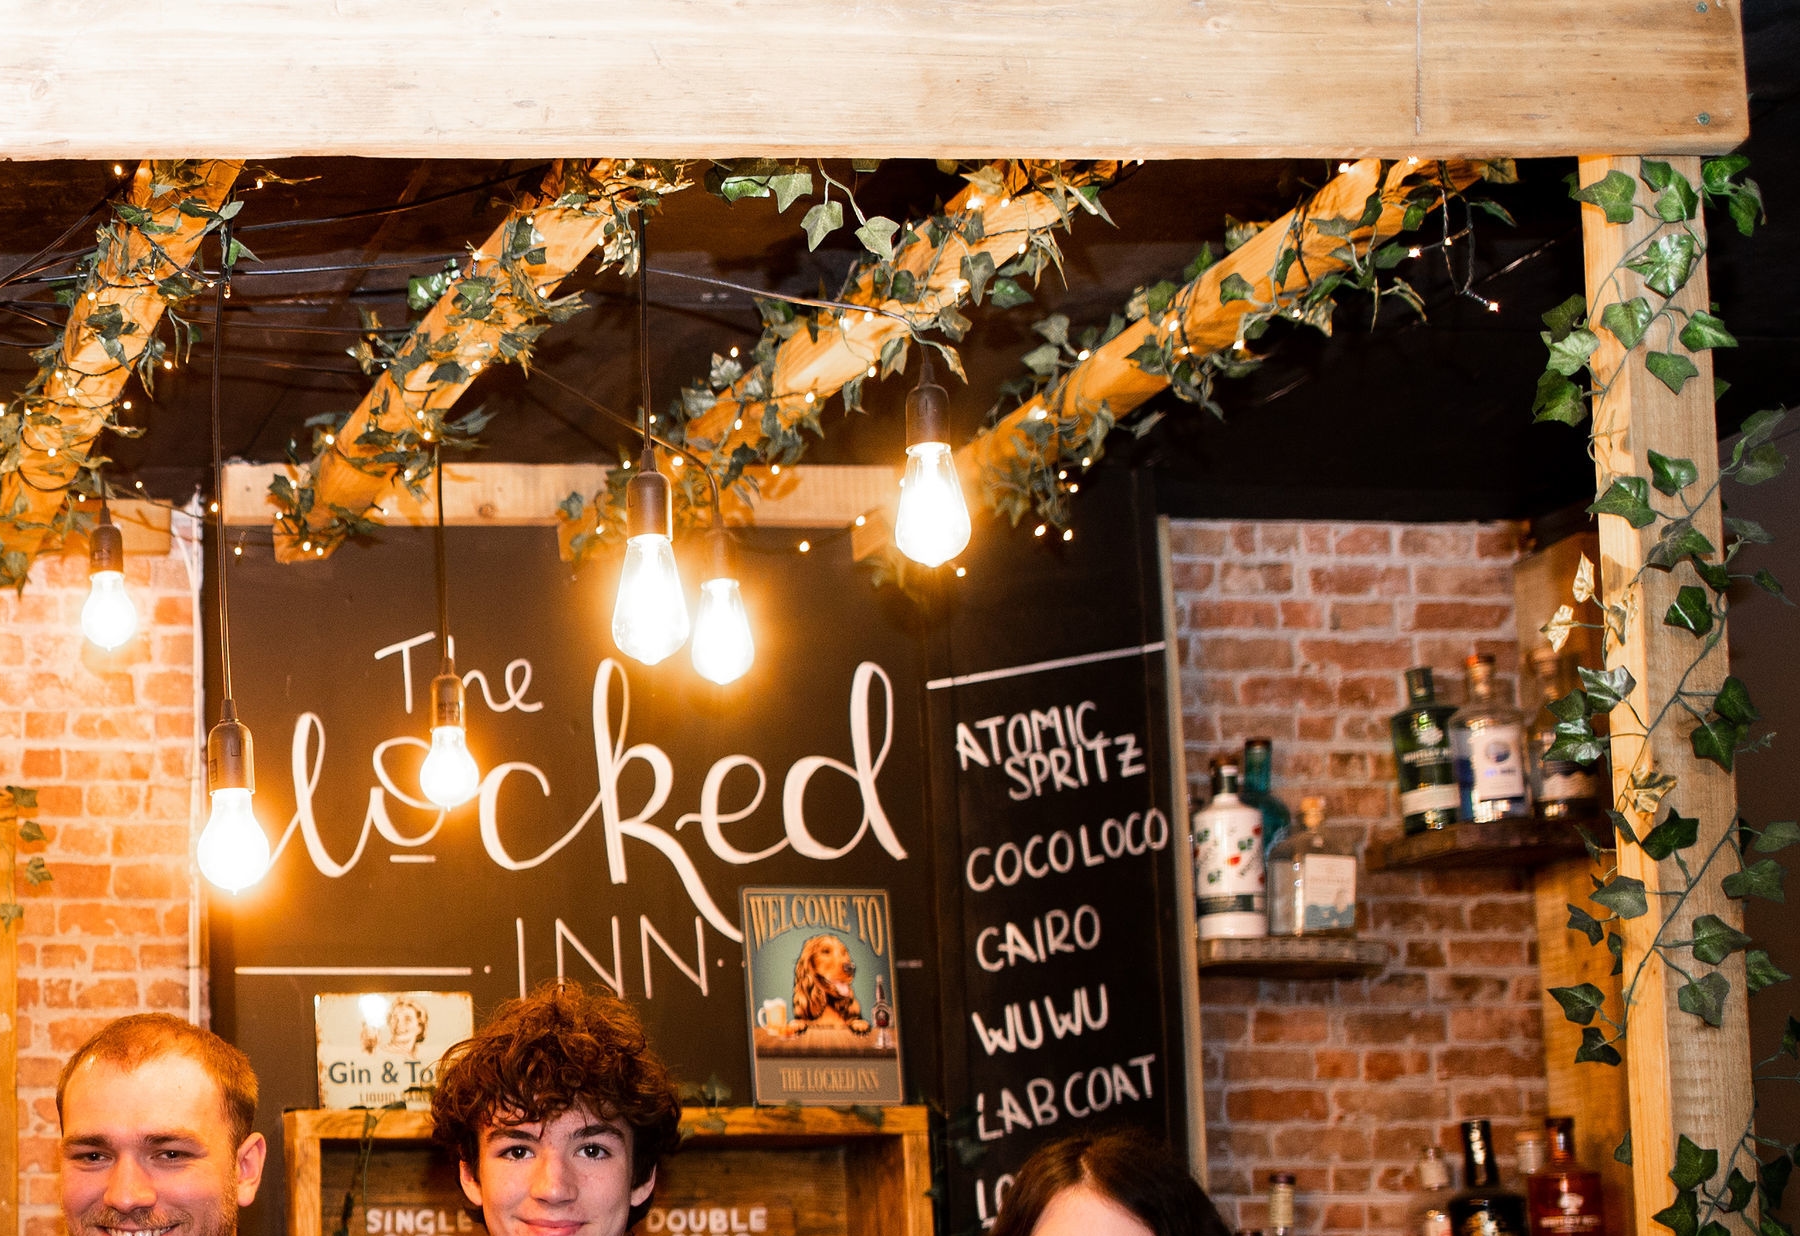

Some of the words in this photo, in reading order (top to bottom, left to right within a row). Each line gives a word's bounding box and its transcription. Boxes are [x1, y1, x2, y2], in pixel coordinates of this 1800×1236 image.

[956, 700, 1099, 770] ATOMIC
[1004, 733, 1147, 801] SPRITZ
[516, 915, 710, 1000] INN
[750, 895, 850, 951] WELCOME
[853, 896, 884, 957] TO
[975, 903, 1101, 974] CAIRO
[329, 1061, 371, 1084] Gin
[381, 1061, 399, 1084] &
[780, 1068, 805, 1091] THE
[807, 1068, 854, 1092] LOCKED
[857, 1068, 880, 1091] INN
[976, 1076, 1058, 1143] LAB
[1064, 1053, 1156, 1119] COAT
[366, 1208, 473, 1235] SINGLE
[646, 1207, 767, 1233] DOUBLE
